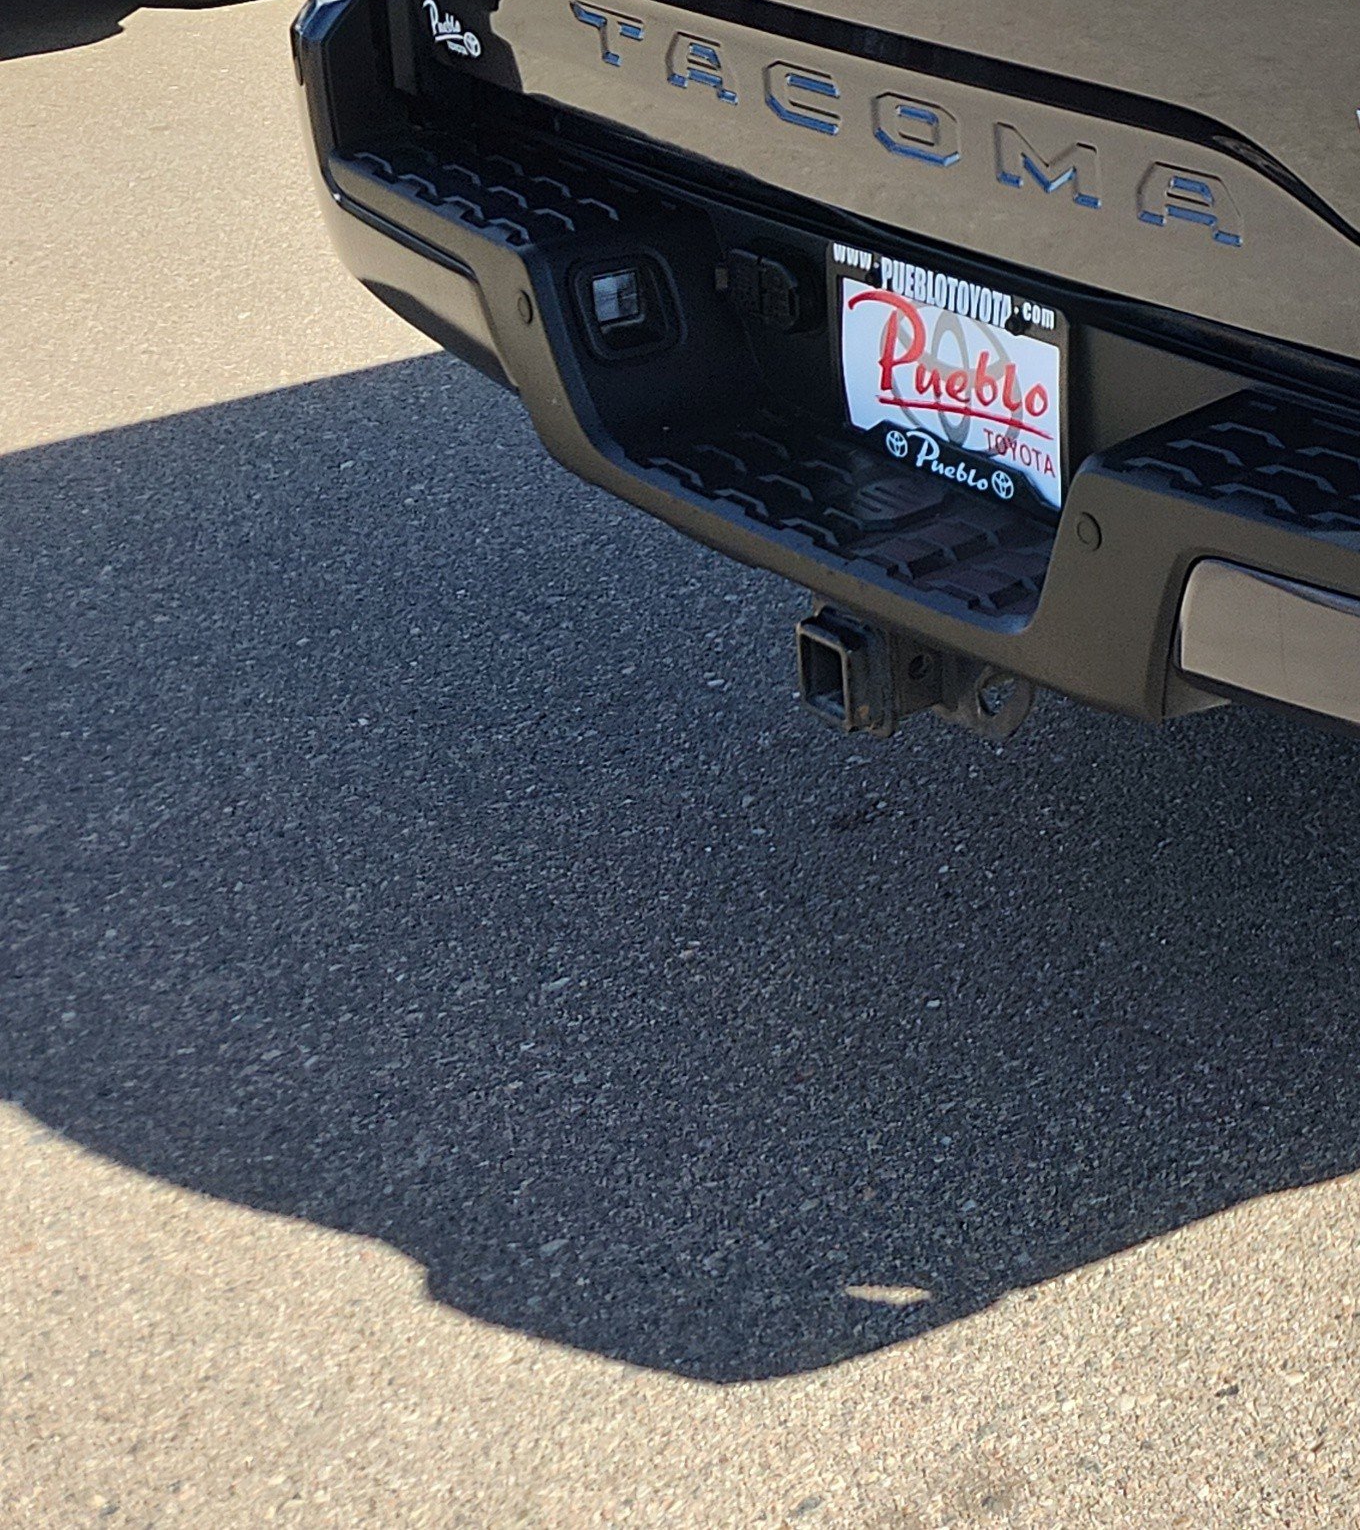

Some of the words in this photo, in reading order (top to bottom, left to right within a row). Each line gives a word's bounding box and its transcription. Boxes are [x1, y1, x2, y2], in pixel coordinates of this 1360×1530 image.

[568, 0, 1244, 247] TACOMA
[848, 290, 1049, 417] Pueblo
[906, 430, 989, 491] Pueblo
[983, 427, 1056, 478] TOYOTA
